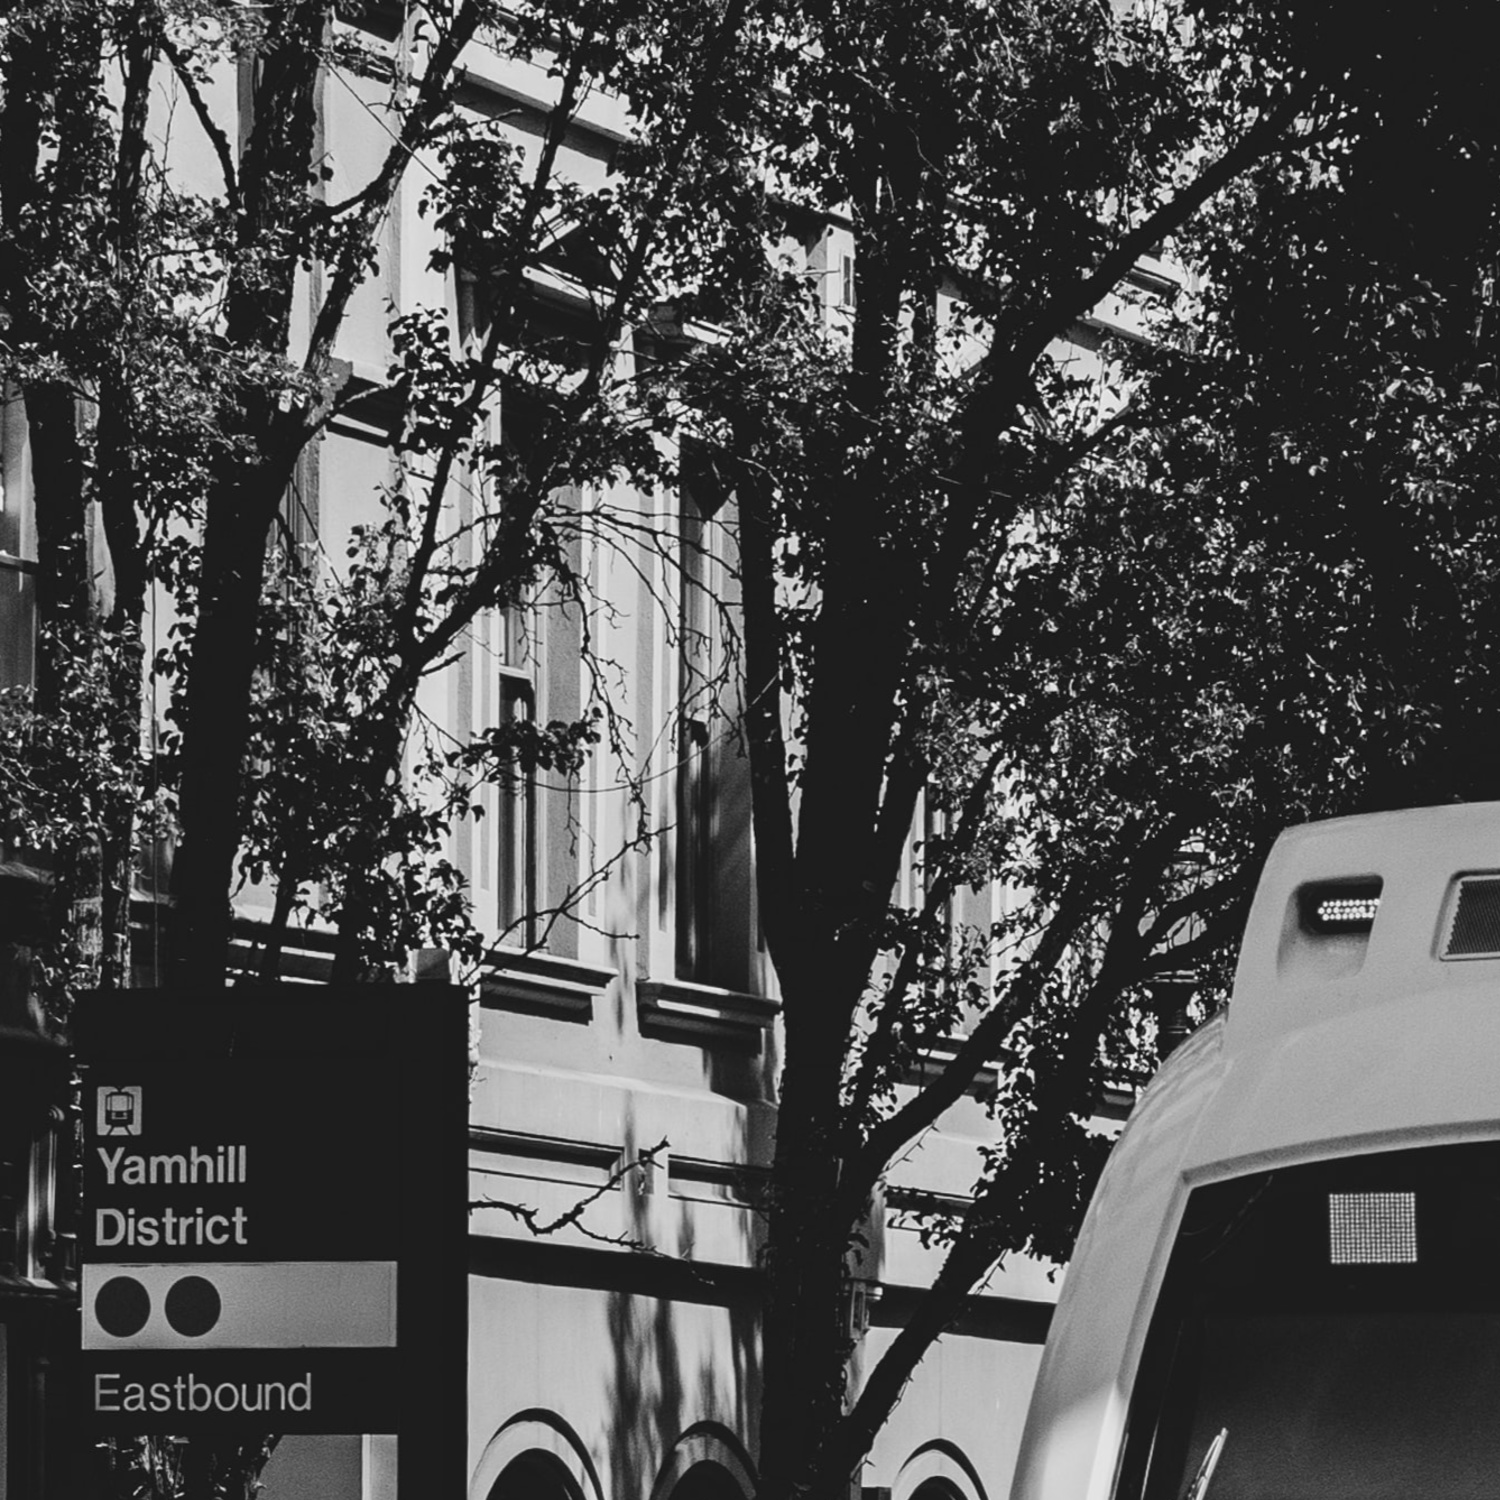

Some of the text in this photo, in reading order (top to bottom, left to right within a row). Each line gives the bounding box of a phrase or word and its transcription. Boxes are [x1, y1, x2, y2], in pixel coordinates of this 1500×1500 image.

[96, 1144, 247, 1185] Yamhill
[95, 1206, 249, 1247] District
[94, 1372, 312, 1412] Eastbound
